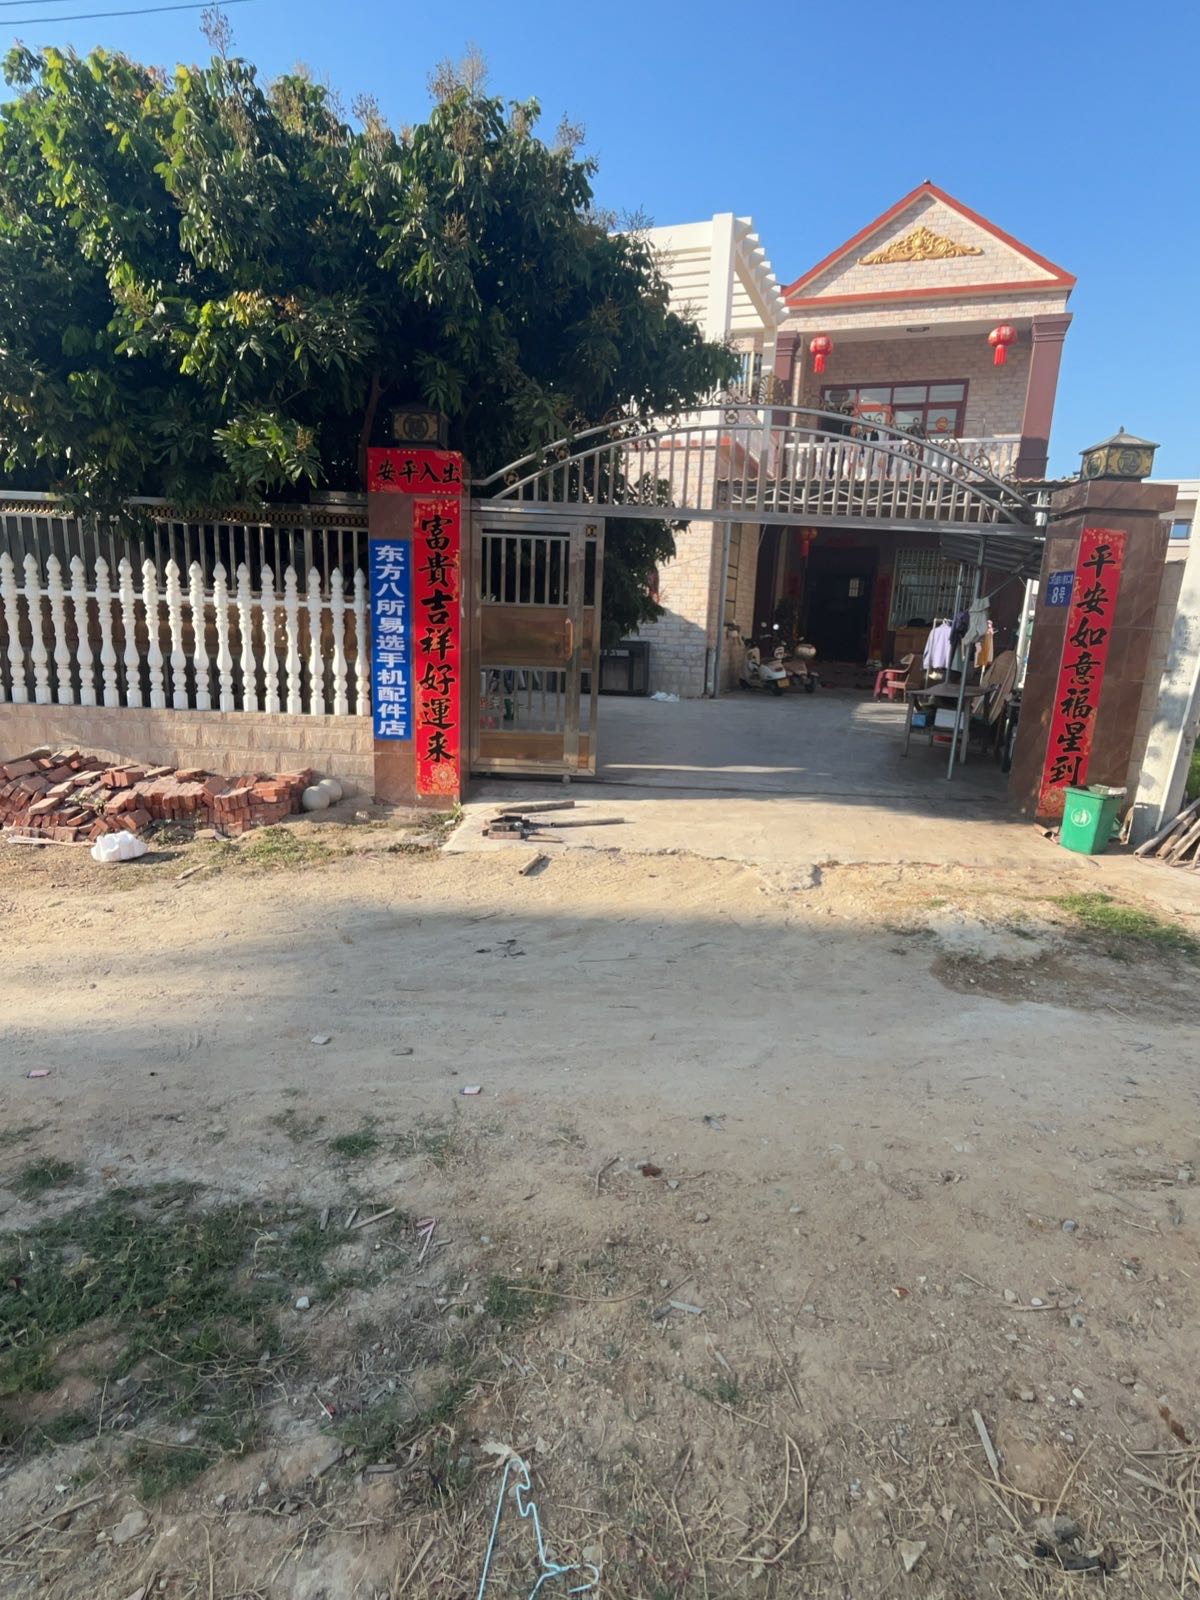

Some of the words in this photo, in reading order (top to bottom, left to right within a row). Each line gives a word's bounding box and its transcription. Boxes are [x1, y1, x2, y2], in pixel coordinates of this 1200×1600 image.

[375, 545, 407, 736] 东方八所易选手机配件店
[1048, 544, 1116, 785] 平安如意福星到
[1051, 586, 1066, 604] 8号
